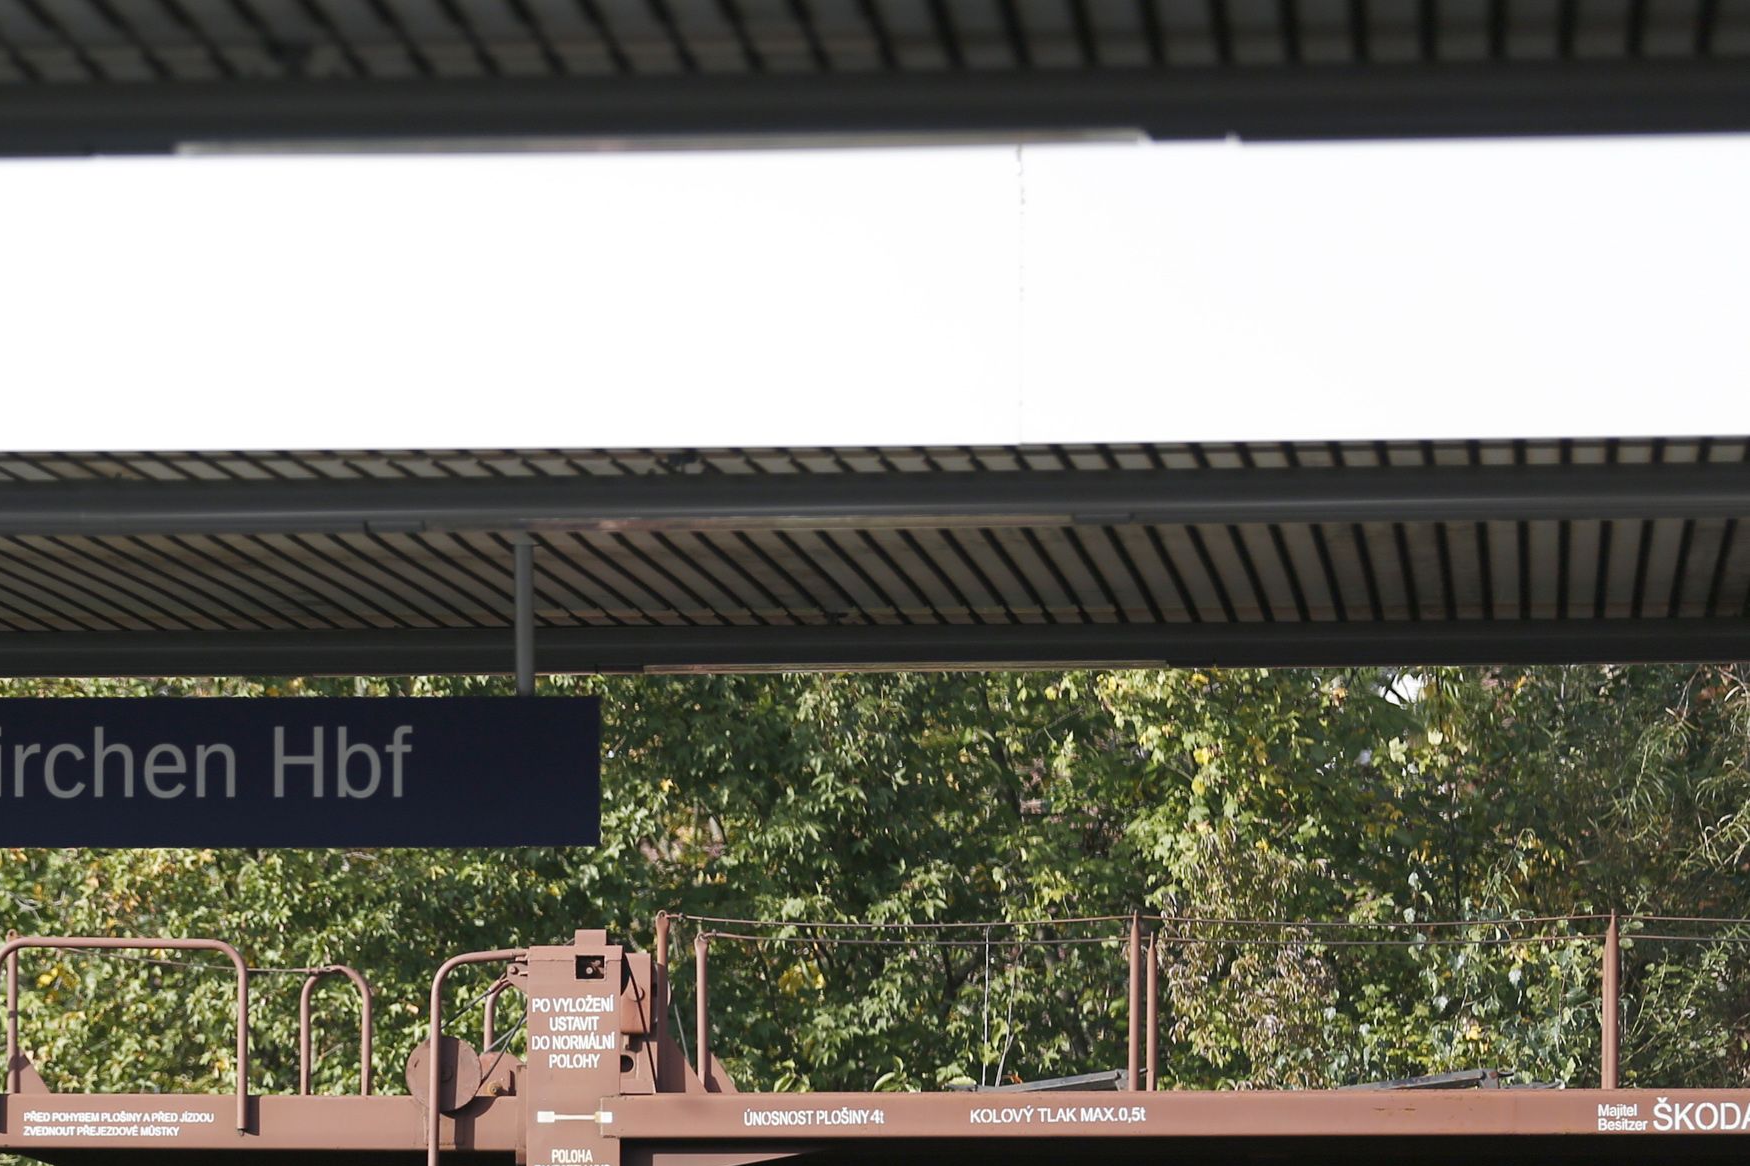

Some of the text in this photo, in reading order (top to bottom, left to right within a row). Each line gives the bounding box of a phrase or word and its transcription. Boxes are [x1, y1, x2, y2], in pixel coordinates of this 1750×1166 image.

[272, 724, 413, 799] Hbf
[532, 994, 614, 1013] PO VYLOŽENÍ
[549, 1016, 599, 1031] USTAVIT
[531, 1032, 615, 1050] DO NORMÁLNÍ
[549, 1053, 600, 1069] POLOHY
[52, 1112, 99, 1123] POHYBEM
[743, 1108, 814, 1127] ÚNOSNOST
[816, 1107, 869, 1126] PLOŠINY
[969, 1106, 1034, 1124] KOLOVÝ
[1037, 1108, 1077, 1123] TLAK
[1597, 1103, 1638, 1119] Majitel
[23, 1126, 75, 1136] ZVEDNOUT
[1597, 1118, 1648, 1131] Besitzer
[551, 1149, 593, 1163] POLOHA
